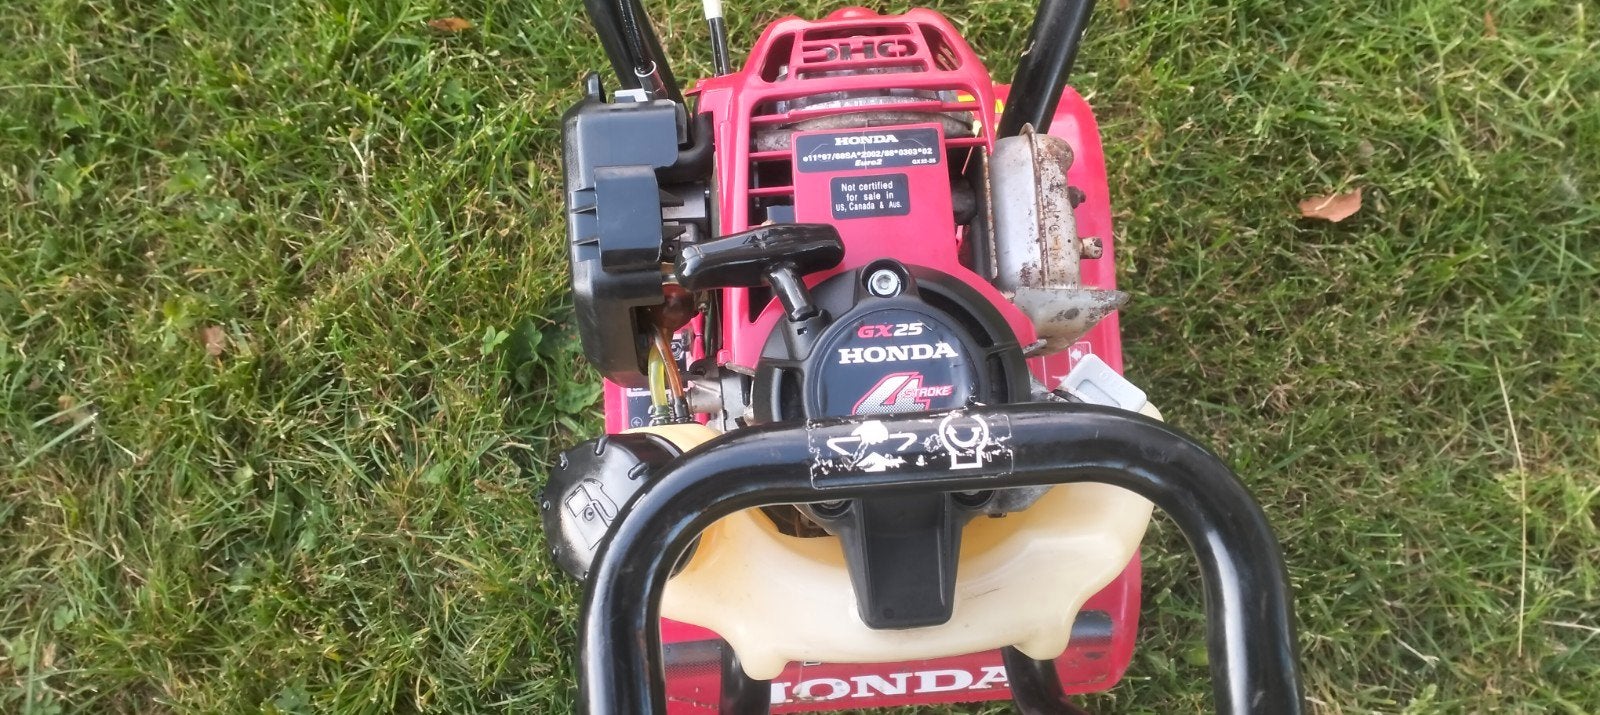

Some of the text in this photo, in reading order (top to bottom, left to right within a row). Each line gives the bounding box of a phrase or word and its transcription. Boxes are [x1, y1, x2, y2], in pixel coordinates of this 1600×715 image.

[834, 134, 898, 146] HONDA
[855, 158, 883, 167] Euro2
[841, 181, 893, 192] Not certified
[846, 191, 894, 202] for sale in
[835, 200, 902, 213] US, Canada & Aus.
[857, 322, 923, 338] GX25
[838, 341, 959, 364] HONDA
[852, 371, 953, 416] 4 STROKE
